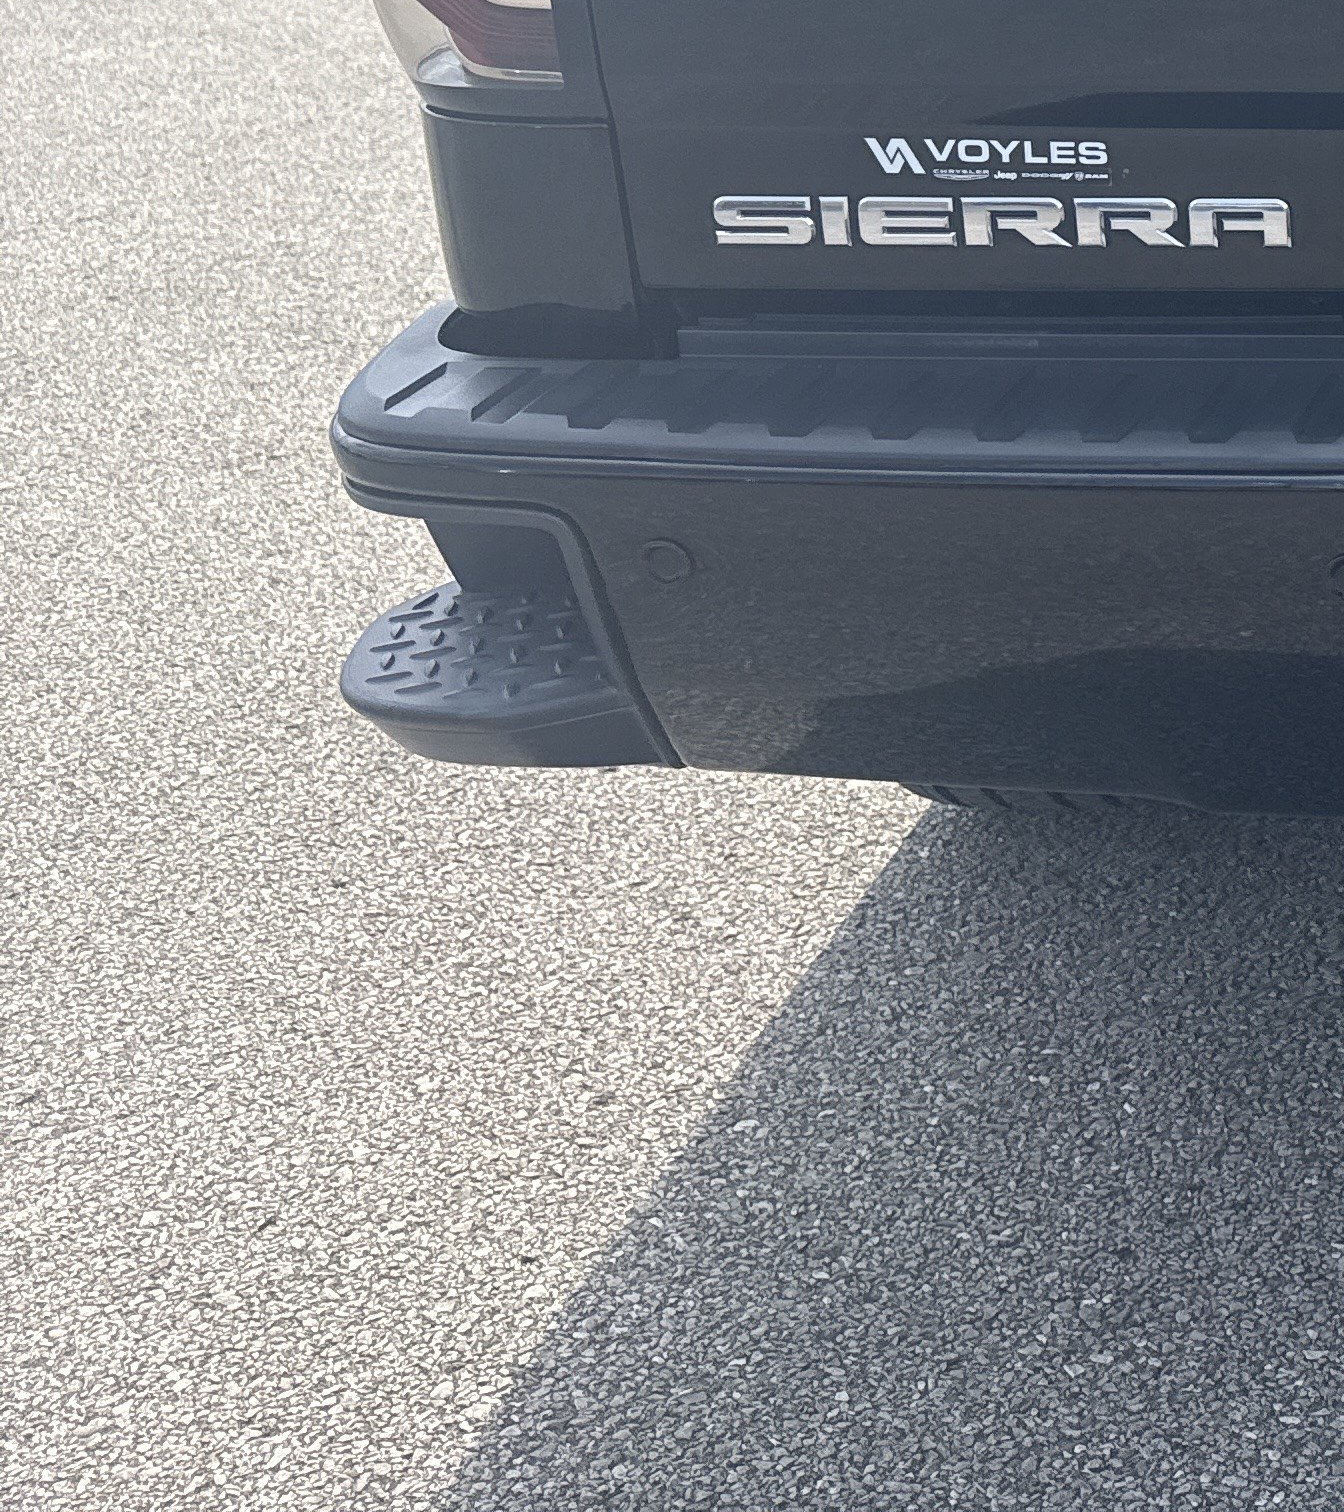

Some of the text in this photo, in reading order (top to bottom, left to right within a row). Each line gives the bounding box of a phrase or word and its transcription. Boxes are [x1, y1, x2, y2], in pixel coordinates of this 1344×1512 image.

[923, 138, 1109, 165] VOYLES
[993, 170, 1018, 181] Jeep
[712, 195, 1293, 248] SIERRA
